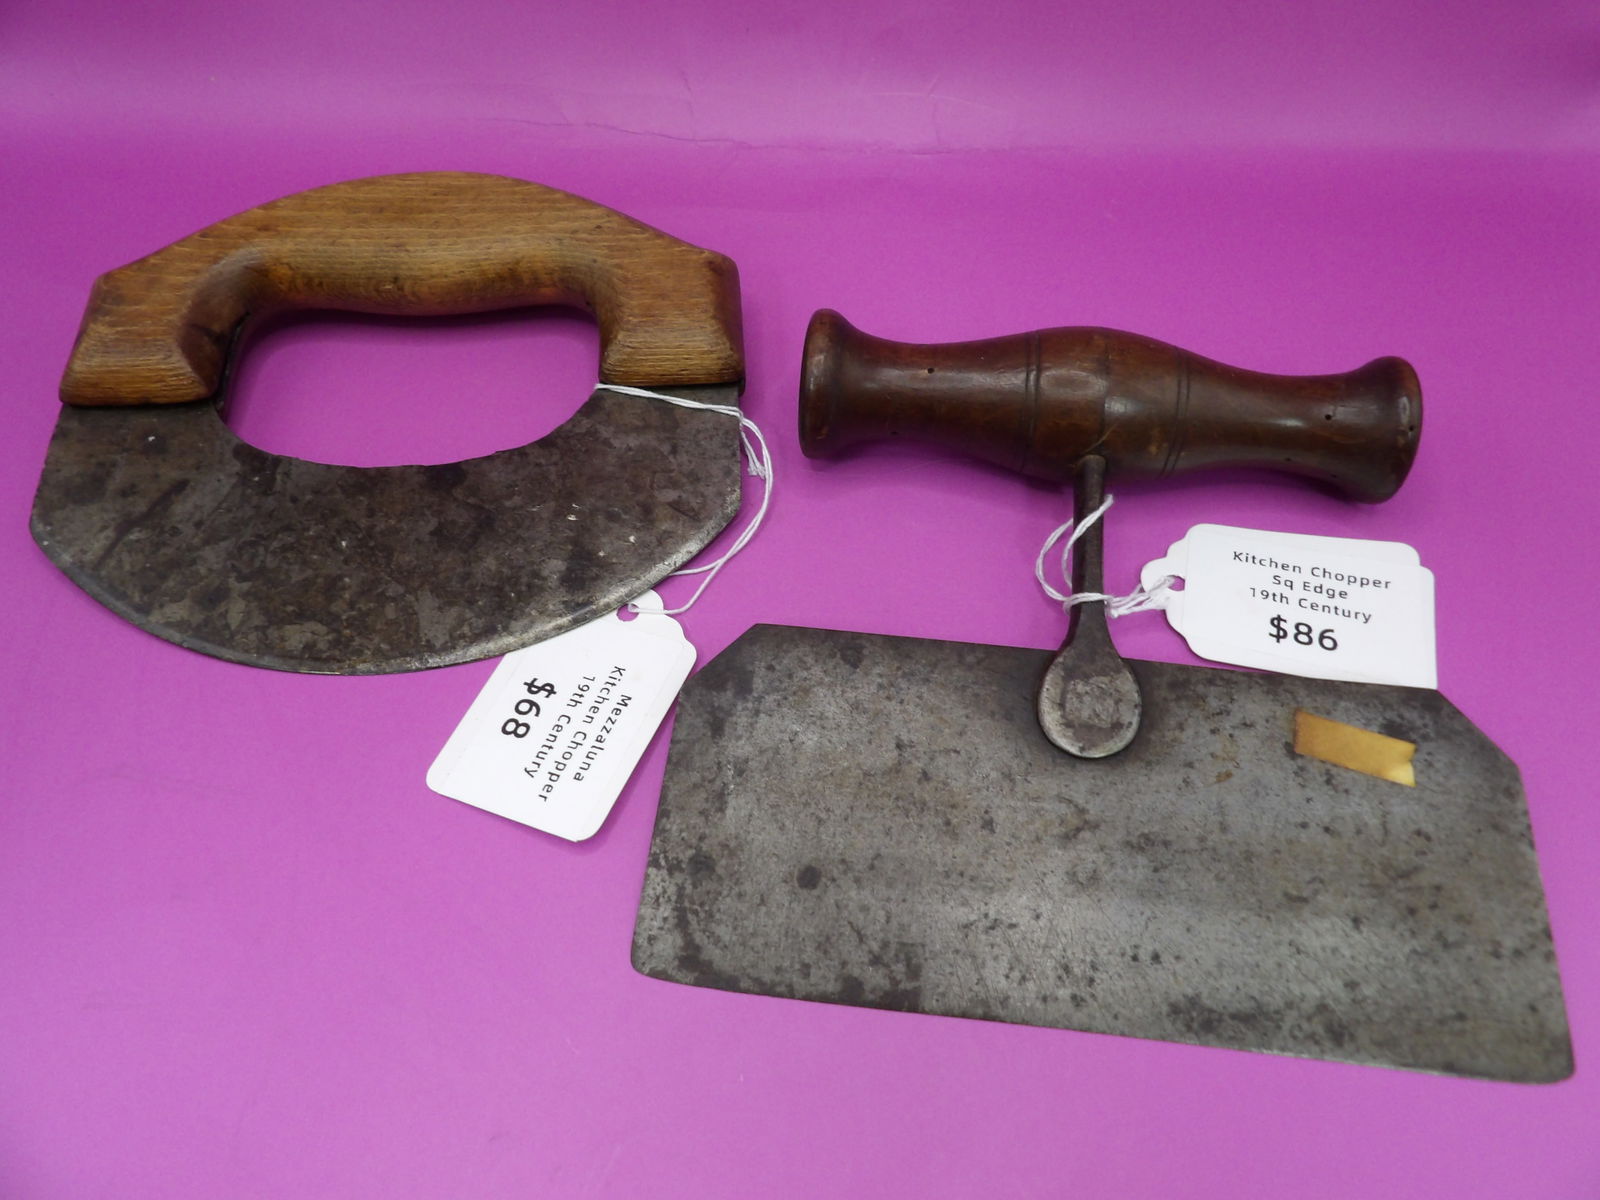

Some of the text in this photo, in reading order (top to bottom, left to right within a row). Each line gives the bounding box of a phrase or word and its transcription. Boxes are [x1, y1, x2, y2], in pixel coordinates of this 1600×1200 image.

[1232, 551, 1392, 589] Kitchen Chopper
[1272, 575, 1349, 599] Sq Edge
[1249, 587, 1372, 624] 19th Century
[1268, 614, 1338, 651] $86
[501, 677, 557, 739] $68
[524, 675, 596, 778] 19th Century
[538, 665, 626, 802] Kitchen Chopper
[573, 694, 632, 782] Mezzaluna
